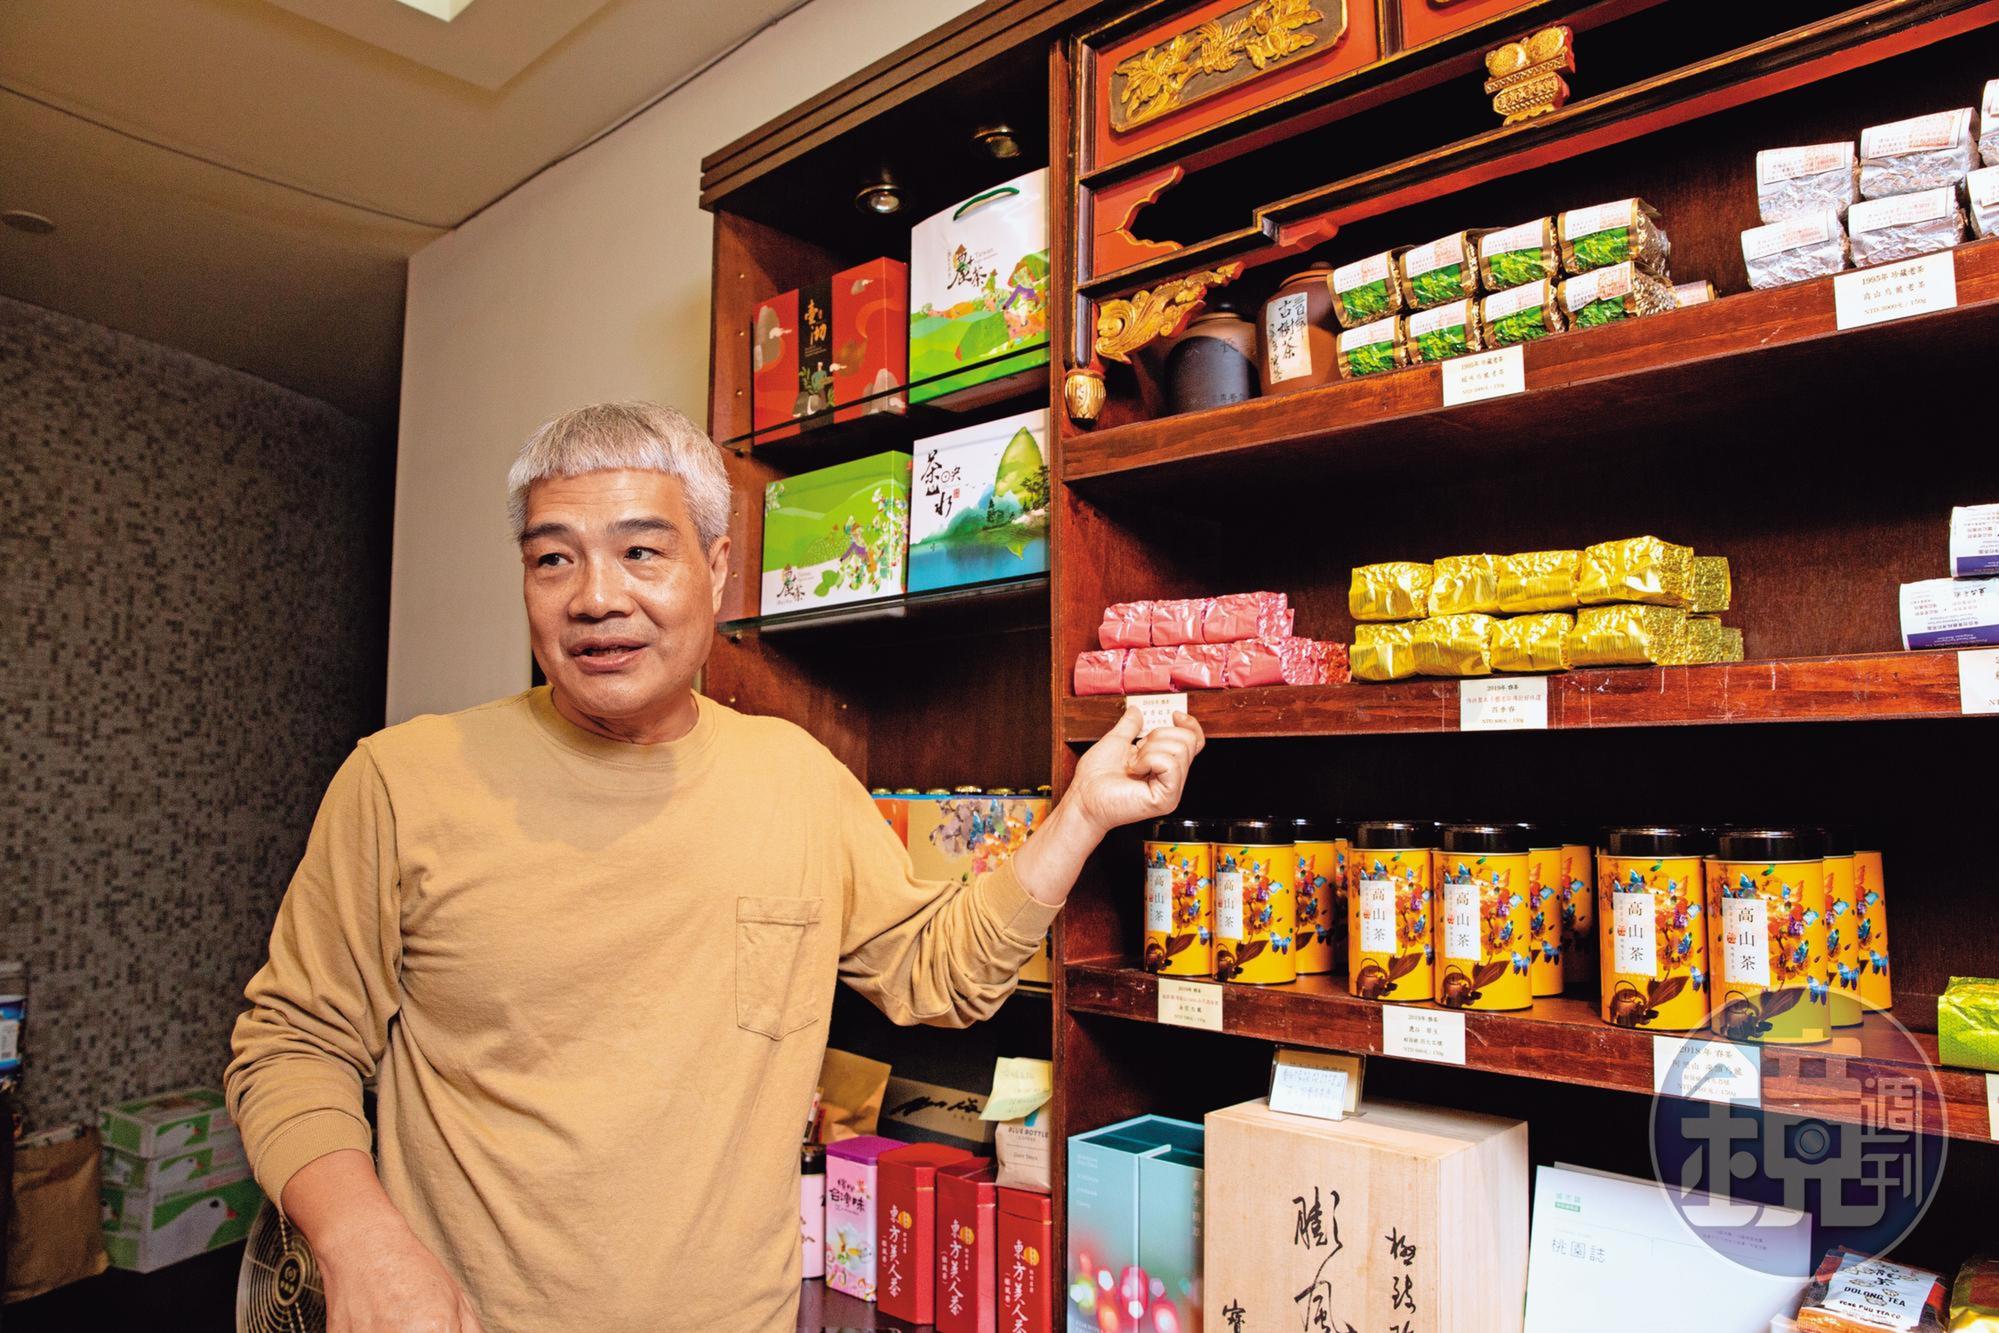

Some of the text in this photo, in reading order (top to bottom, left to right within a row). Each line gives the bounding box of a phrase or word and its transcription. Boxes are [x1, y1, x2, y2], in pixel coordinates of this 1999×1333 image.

[1154, 874, 1165, 922] 高山茶
[1223, 880, 1235, 928] 高山茶
[1372, 887, 1386, 941] 高山茶
[1456, 891, 1471, 947] 高山茶
[1628, 901, 1644, 962] 高山茶
[1738, 907, 1756, 971] 高山茶
[1007, 1126, 1049, 1138] BLUE BOTTLE
[888, 1204, 902, 1297] 東方美人茶
[948, 1218, 964, 1316] 東方美人茶
[1551, 1238, 1606, 1264] 桃園誌
[1011, 1239, 1029, 1333] 東方美人茶
[1888, 1296, 1906, 1307] TEA
